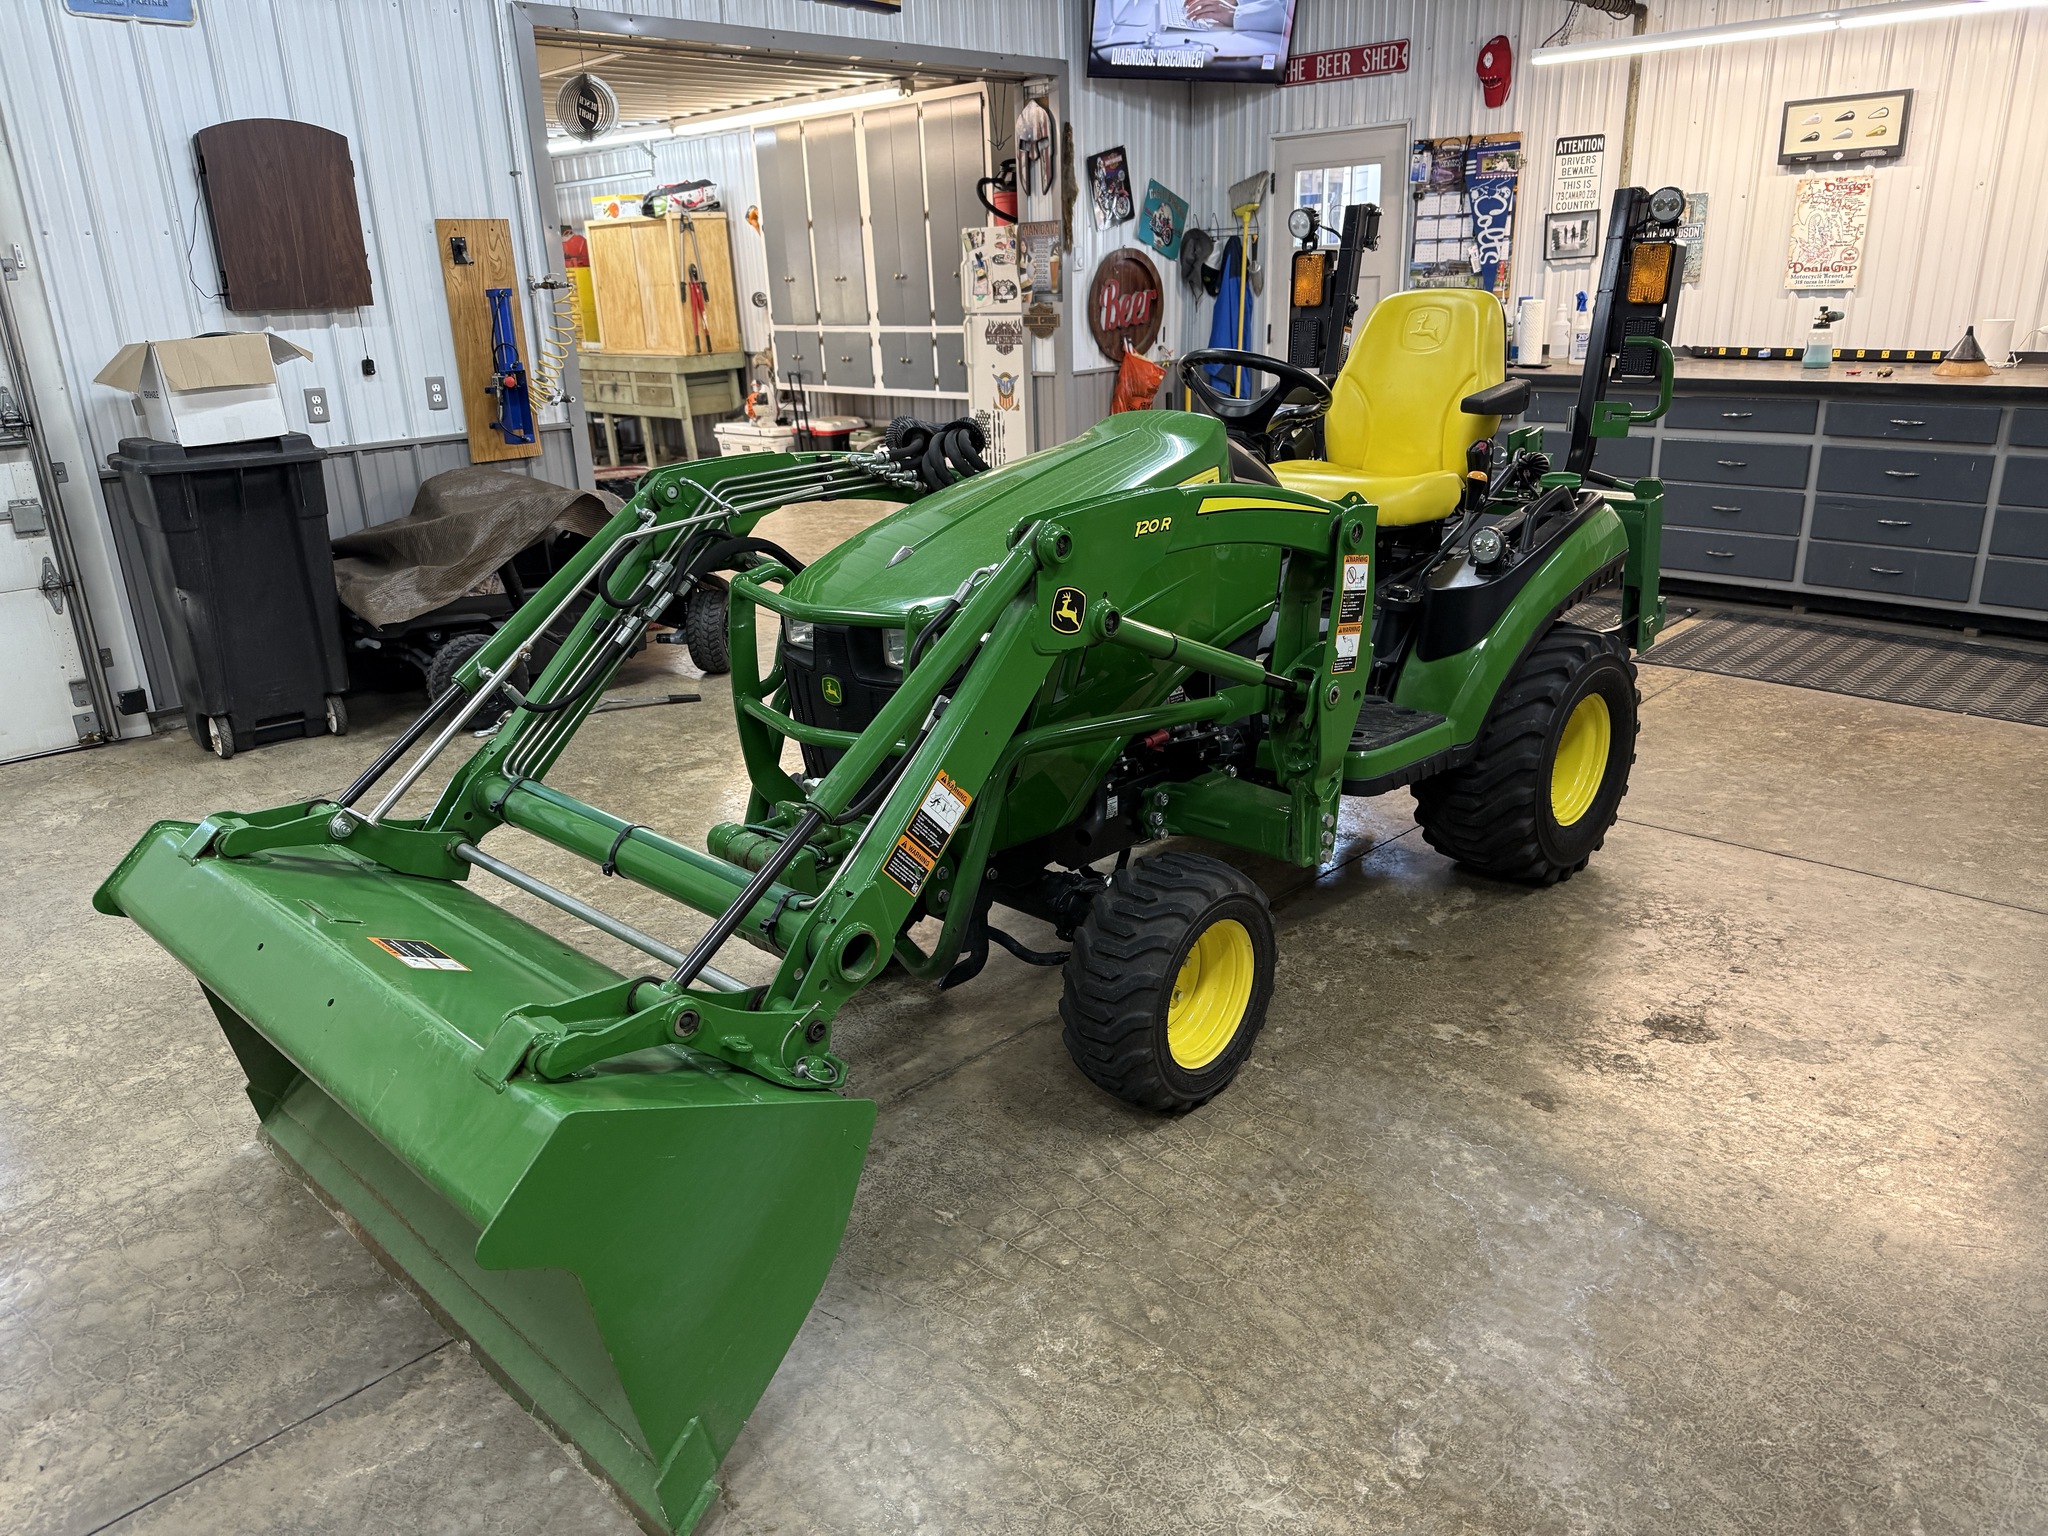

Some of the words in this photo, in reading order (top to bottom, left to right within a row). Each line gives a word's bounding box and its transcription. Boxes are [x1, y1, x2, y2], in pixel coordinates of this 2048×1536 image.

[1111, 47, 1156, 67] DIAGNOSIS:
[1156, 49, 1206, 68] DISCONNECT
[1285, 58, 1306, 83] HE
[1316, 52, 1351, 79] BEER
[1361, 45, 1399, 73] SHED
[1557, 137, 1604, 154] ATTENTION
[1561, 155, 1597, 167] DRIVERS
[1561, 166, 1595, 177] BEWARE
[1563, 181, 1581, 190] THIS
[1583, 179, 1592, 189] IS
[1824, 181, 1871, 196] Dragon
[1565, 190, 1586, 201] CAMARO
[1586, 189, 1597, 199] Z28
[1555, 200, 1595, 211] COUNTRY
[1022, 224, 1038, 236] MAN
[1473, 195, 1508, 265] Colts
[1830, 260, 1858, 274] Gap
[1099, 279, 1157, 331] Beer
[1341, 625, 1361, 633] WARNING
[946, 780, 968, 803] WARNING
[908, 844, 931, 867] WARNING
